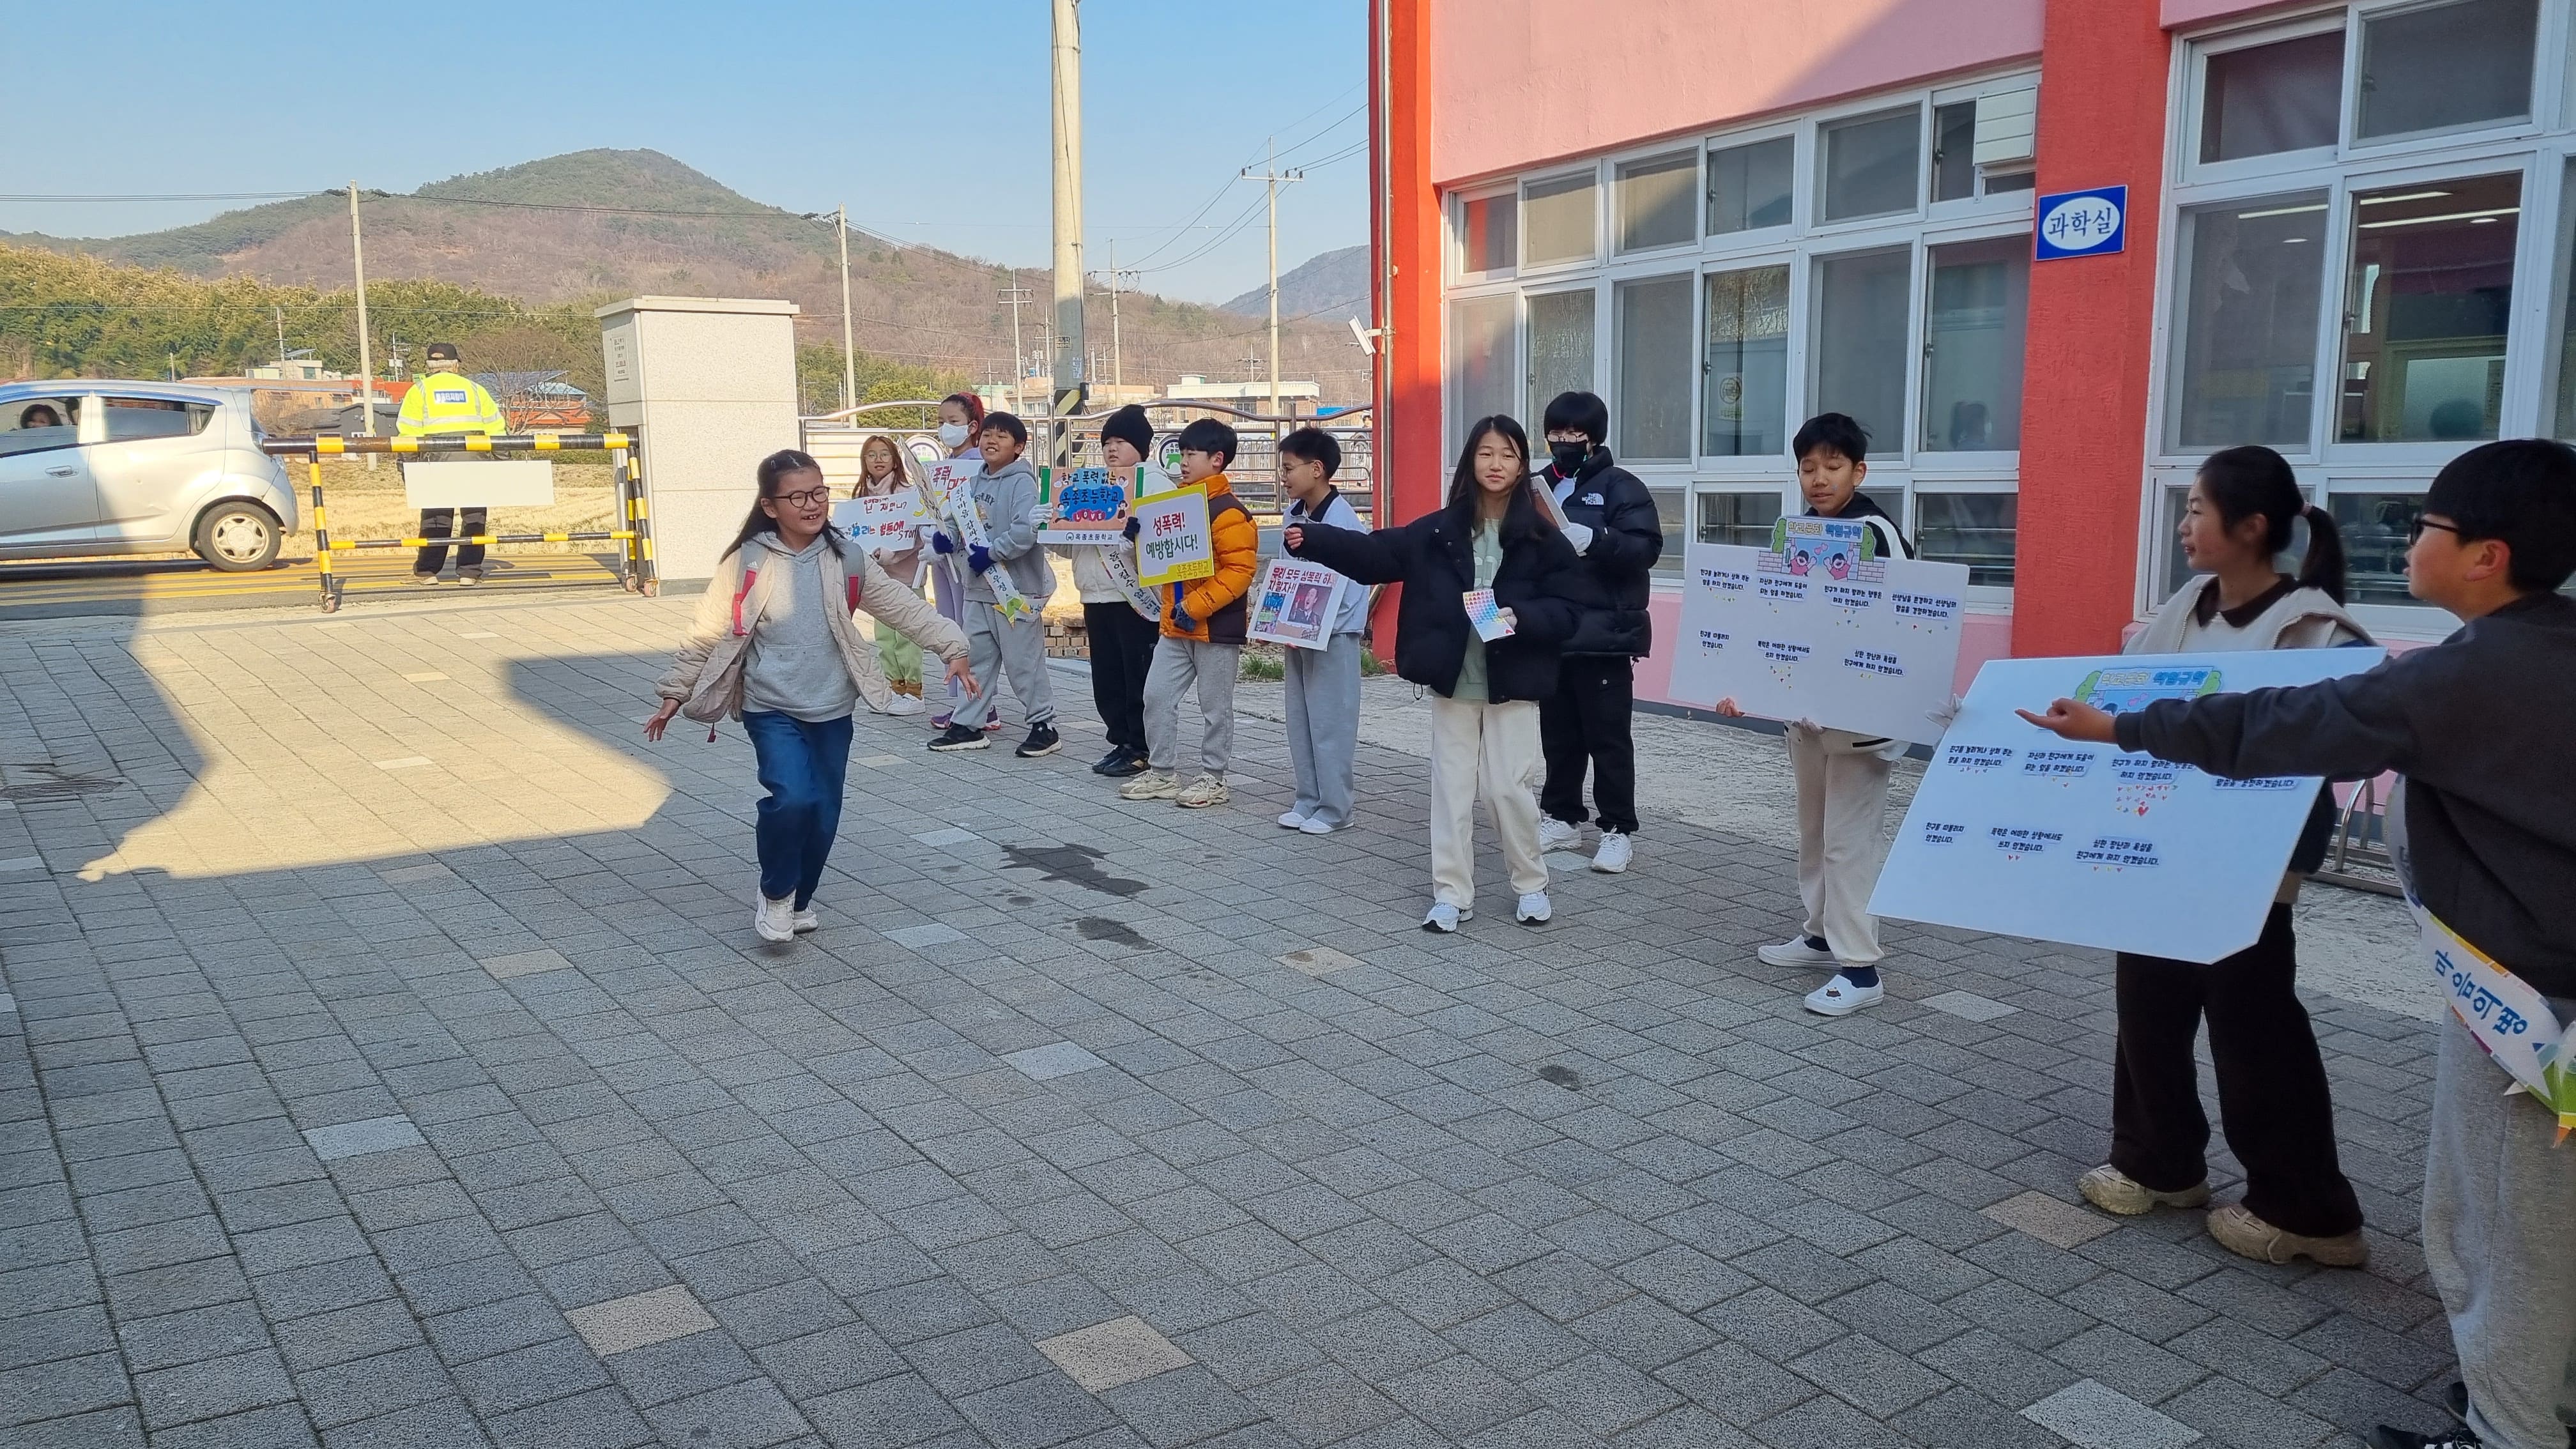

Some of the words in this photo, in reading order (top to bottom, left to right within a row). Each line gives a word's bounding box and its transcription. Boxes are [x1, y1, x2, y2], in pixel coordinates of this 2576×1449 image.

[2048, 207, 2112, 240] 과학실
[933, 465, 953, 487] 폭력
[1062, 472, 1080, 486] 학교
[1082, 471, 1099, 485] 폭력
[1102, 471, 1117, 486] 없는
[1061, 488, 1119, 505] 옥종초등학교
[1076, 511, 1103, 521] LOVE
[1153, 512, 1186, 537] 성폭력!
[1075, 533, 1114, 541] 옥종초등학교
[1146, 533, 1199, 560] 예방합시다!
[1273, 567, 1286, 580] 우리
[1285, 568, 1301, 581] 모두
[1774, 579, 1793, 588] 친구에게
[1794, 581, 1807, 589] 도움이
[1781, 590, 1804, 599] 하겠습니다.
[1824, 585, 1837, 594] 친구가
[1851, 588, 1866, 597] 말라는
[1845, 597, 1870, 608] 않겠습니다.
[1892, 593, 1912, 603] 선생님을
[1699, 630, 1712, 638] 친구를
[1702, 640, 1724, 649] 않겠습니다.
[1788, 644, 1810, 654] 상황에서도
[1775, 653, 1799, 662] 않겠습니다.
[1844, 658, 1864, 668] 친구에게
[1878, 665, 1904, 676] 않겠습니다.
[1949, 745, 1964, 754] 친구를
[1989, 747, 2001, 756] 상처
[2002, 748, 2012, 756] 주는
[1961, 756, 1972, 765] 하지
[1974, 757, 2003, 767] 않겠습니다.
[2027, 751, 2046, 760] 자신과
[2048, 752, 2074, 761] 친구에게
[2076, 753, 2095, 762] 도움이
[2024, 763, 2036, 772] 되는
[2053, 764, 2085, 773] 하겠습니다.
[2112, 758, 2131, 768] 친구가
[2134, 759, 2148, 768] 하지
[2120, 770, 2134, 779] 하지
[2137, 771, 2173, 781] 않겠습니다.
[1926, 822, 1941, 831] 친구를
[1942, 824, 1965, 832] 따돌리지
[1926, 834, 1953, 844] 않겠습니다.
[1991, 827, 2008, 837] 폭력은
[2010, 829, 2029, 839] 어떠한
[2031, 831, 2064, 841] 상황에서도
[2012, 841, 2044, 852] 않겠습니다.
[2092, 839, 2108, 848] 심한
[2110, 840, 2131, 850] 장난과
[2133, 842, 2153, 853] 욕설을
[2076, 850, 2104, 860] 친구에게
[2106, 853, 2122, 862] 하지
[2122, 855, 2159, 866] 않겠습니다.
